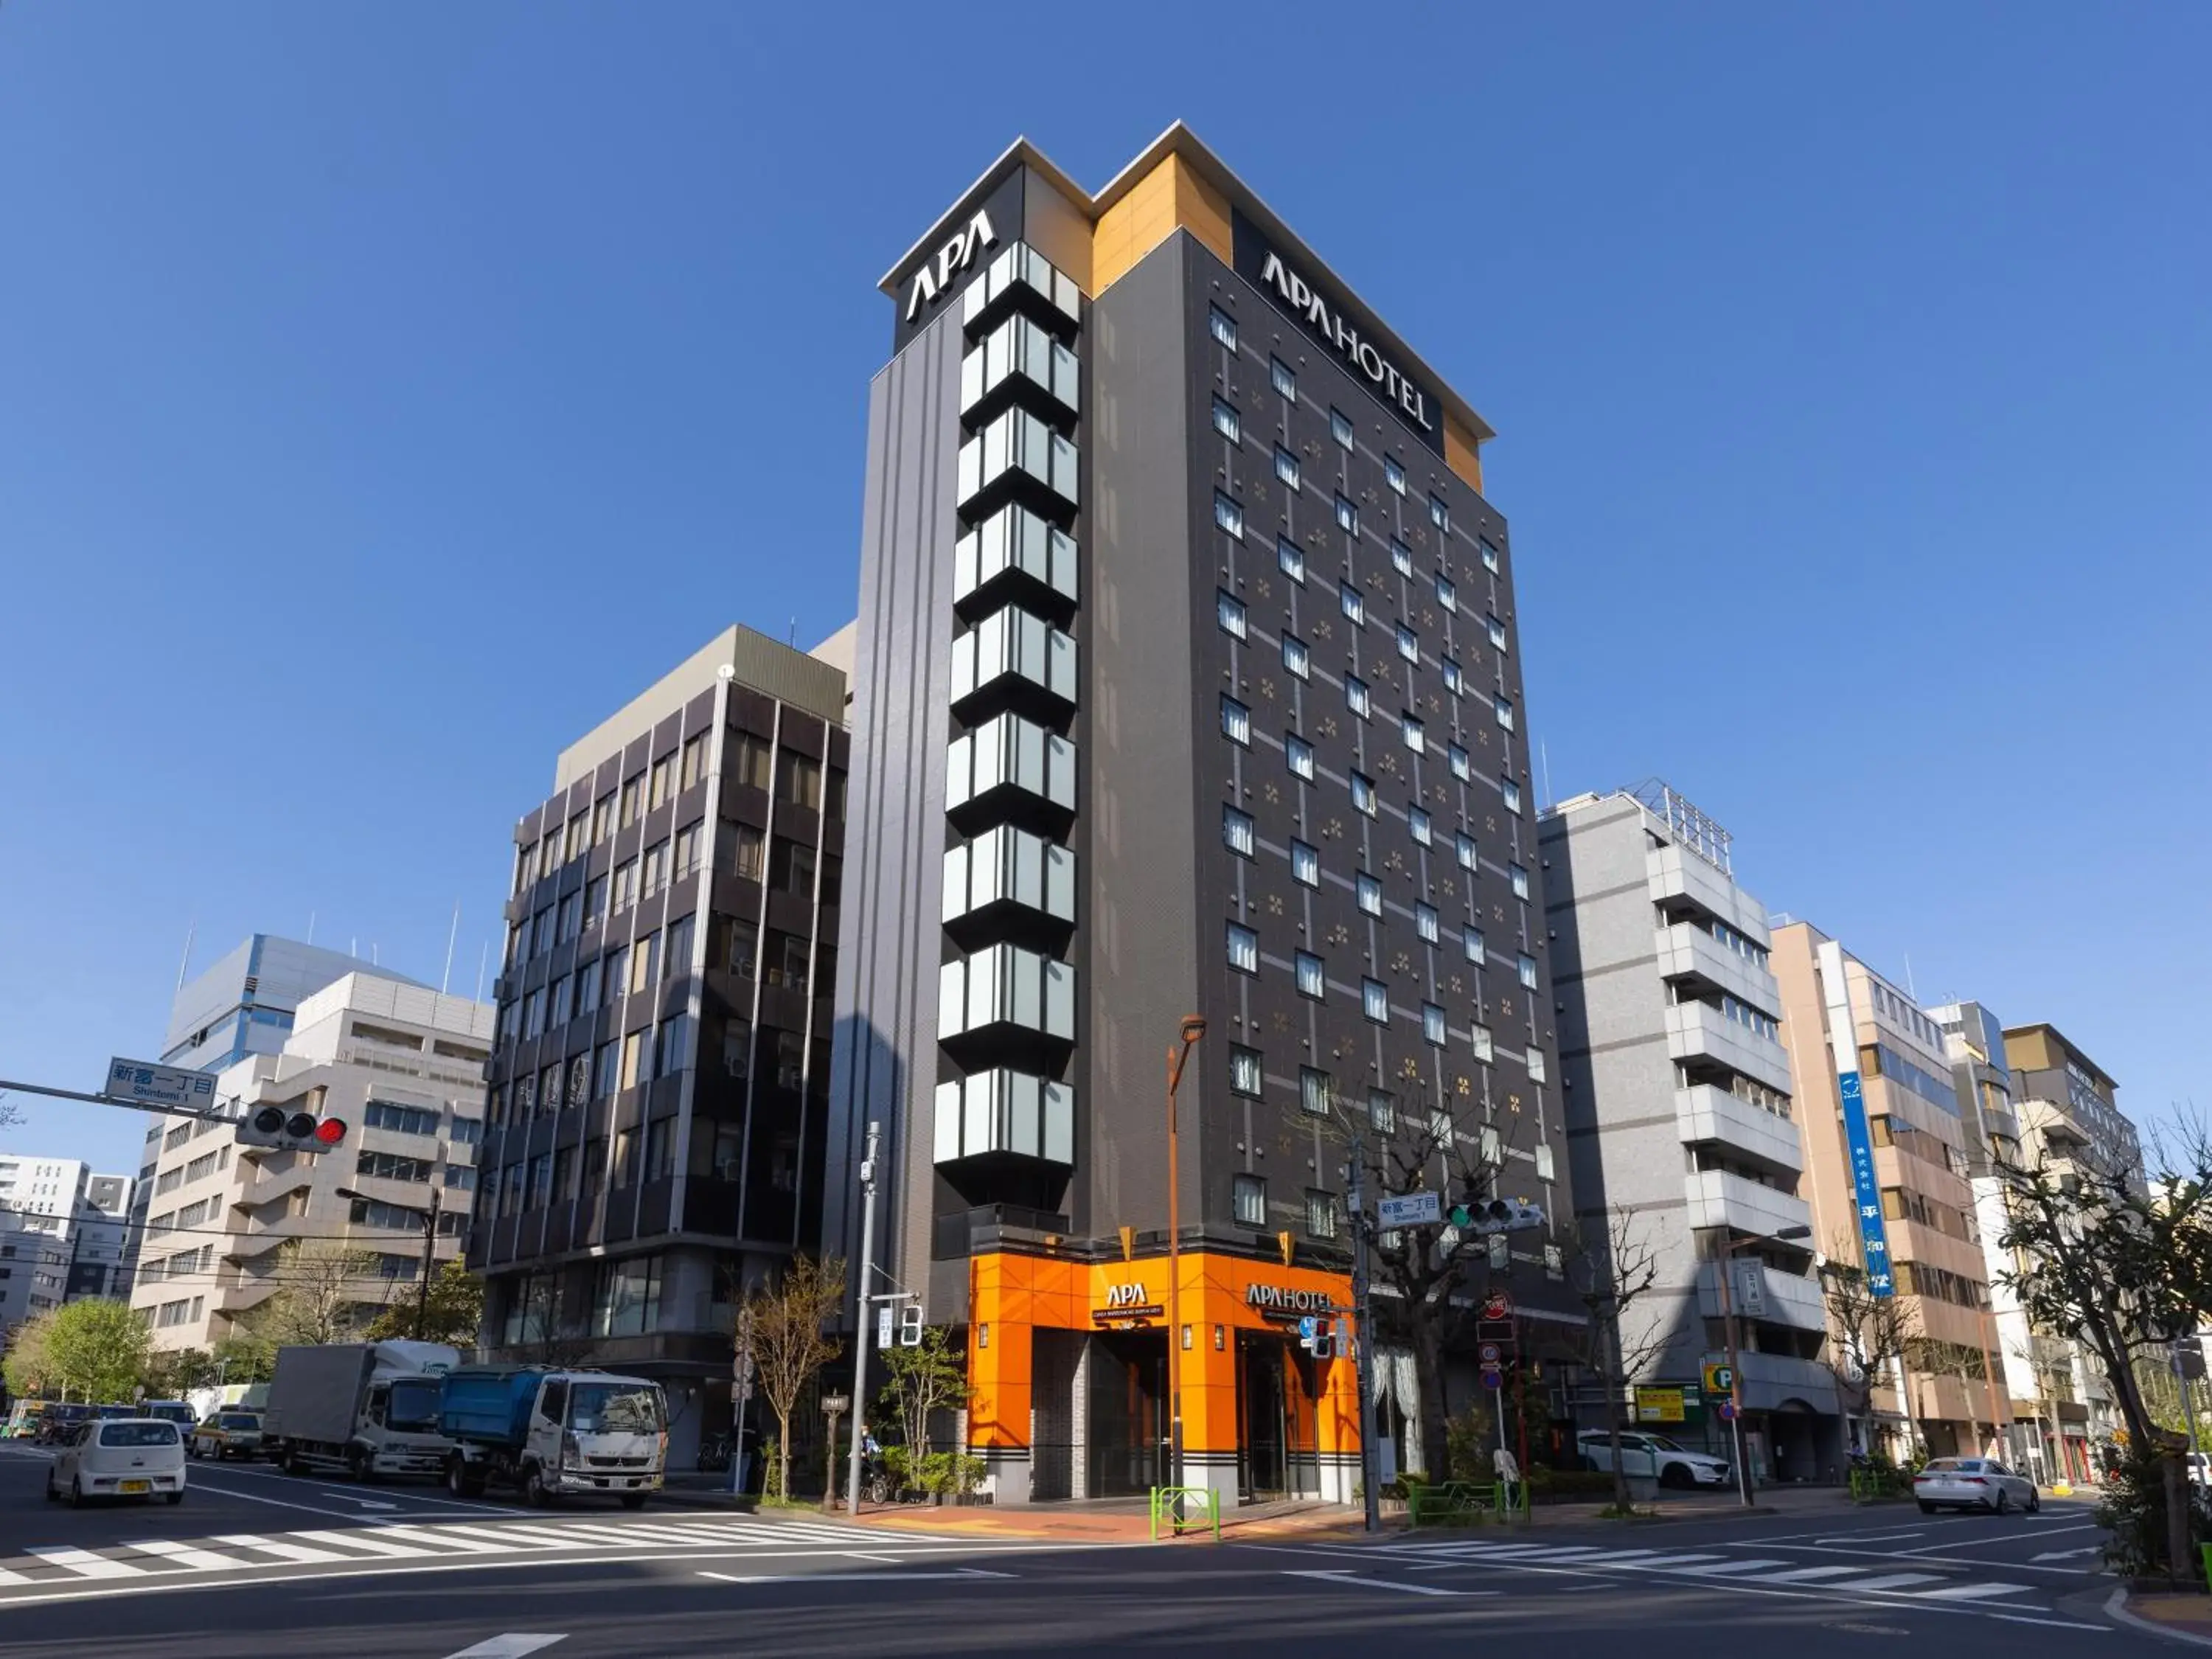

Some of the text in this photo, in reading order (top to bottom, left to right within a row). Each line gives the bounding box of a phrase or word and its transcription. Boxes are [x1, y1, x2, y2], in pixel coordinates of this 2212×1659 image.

[906, 209, 994, 321] APA
[1264, 251, 1433, 431] APA HOTEL
[113, 1064, 212, 1095] 新富一丁目
[133, 1085, 179, 1101] Shintomi
[1107, 1283, 1146, 1306] APA
[1248, 1284, 1335, 1312] APA HOTEL
[1720, 1369, 1732, 1387] P
